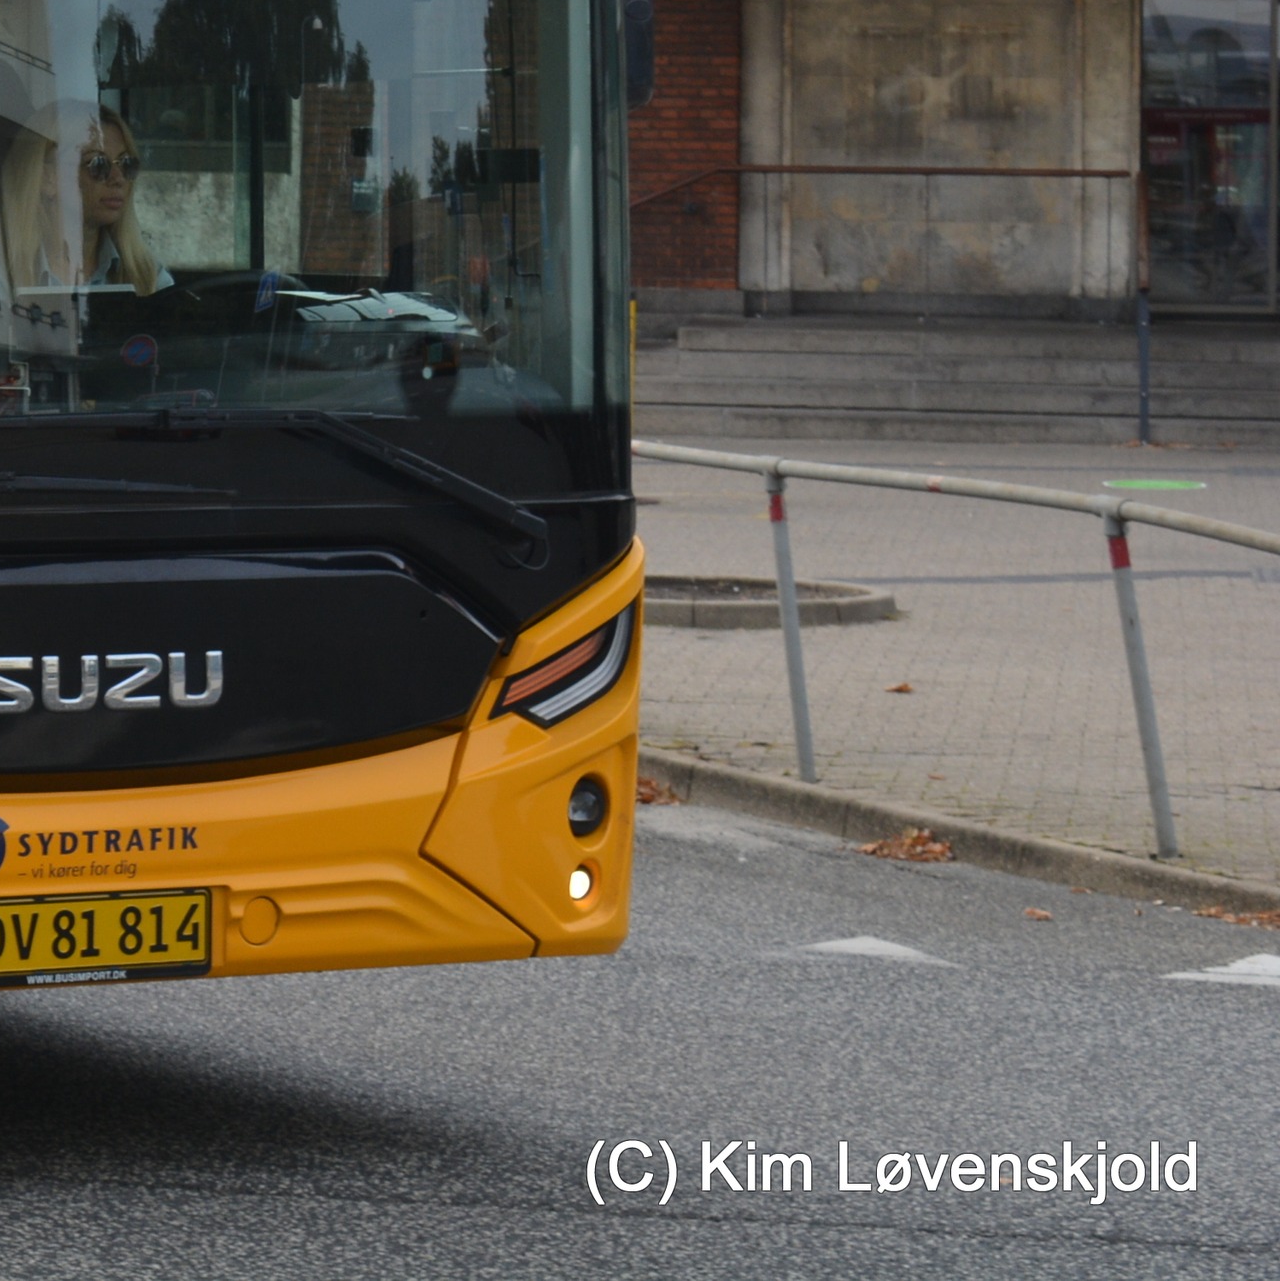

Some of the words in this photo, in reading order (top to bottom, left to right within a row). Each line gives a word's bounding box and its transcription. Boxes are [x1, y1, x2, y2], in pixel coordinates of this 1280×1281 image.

[18, 826, 198, 857] SYDTRAFIK
[31, 864, 43, 879] vi
[48, 863, 85, 879] kører
[89, 861, 109, 877] for
[114, 860, 137, 878] dig
[51, 909, 100, 960] 81
[118, 903, 199, 956] 814
[26, 970, 128, 985] WWW.BUSIMPORT.DK
